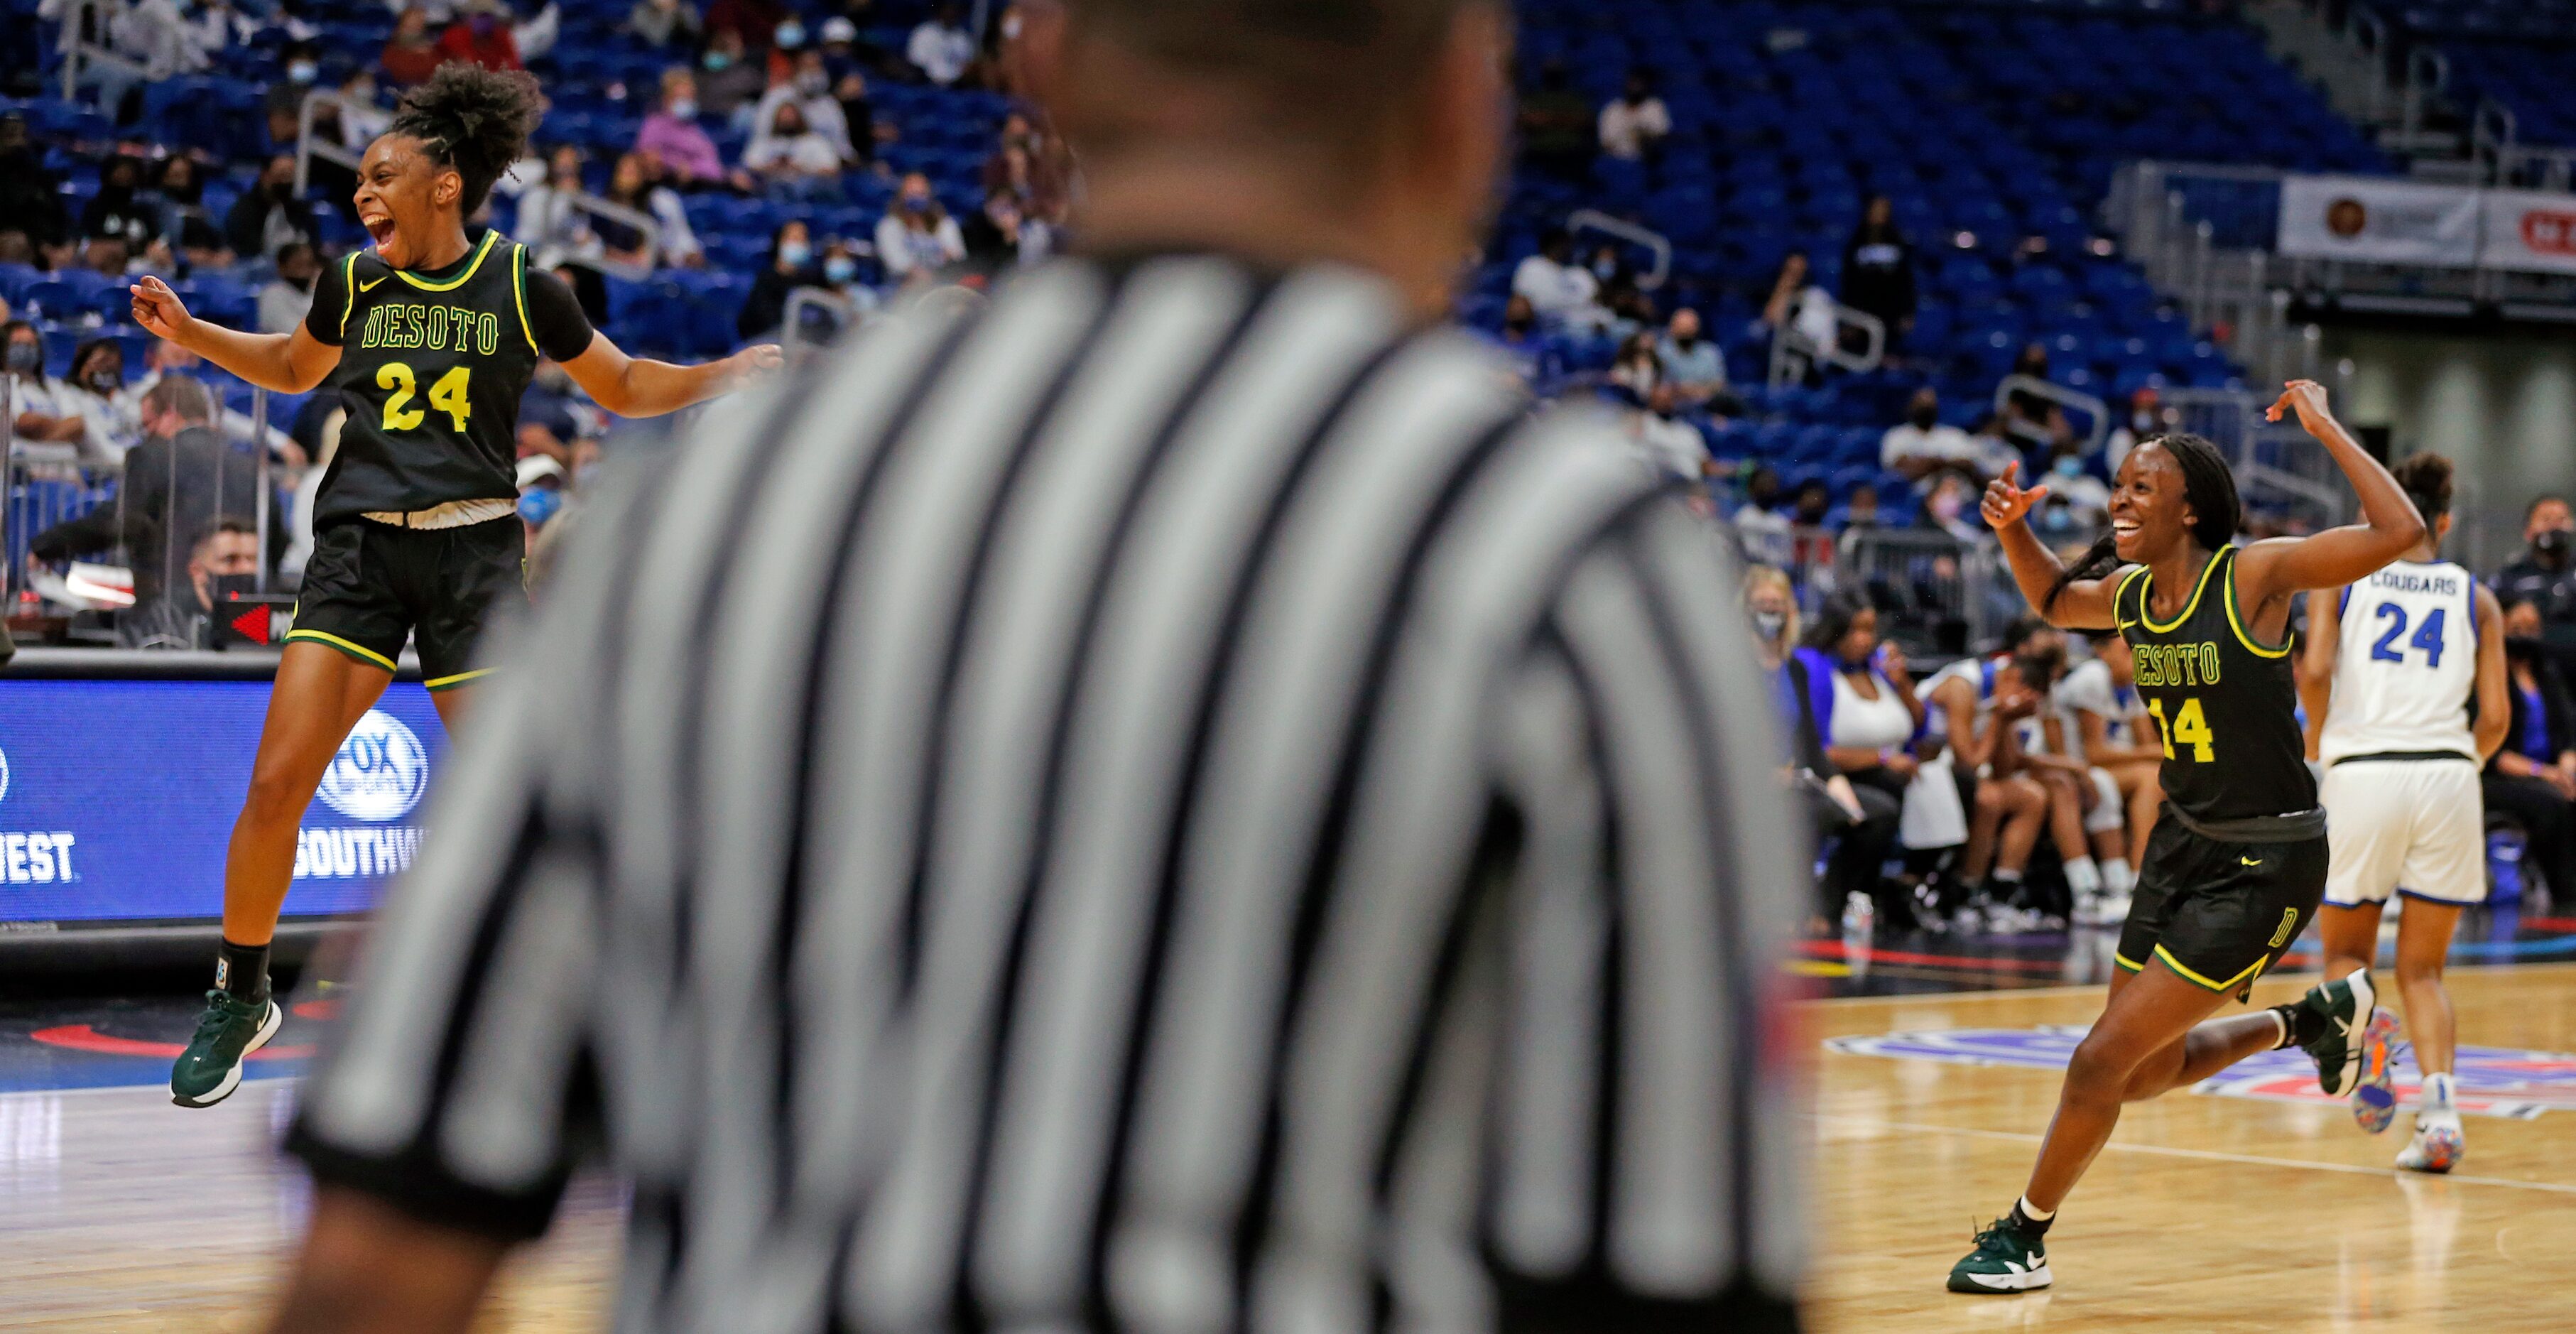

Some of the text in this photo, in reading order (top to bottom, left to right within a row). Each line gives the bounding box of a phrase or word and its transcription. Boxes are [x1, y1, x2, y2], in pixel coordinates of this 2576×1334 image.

[362, 303, 499, 356] DESOTO
[376, 362, 471, 433] 24
[2370, 571, 2457, 596] COUGARS
[2371, 602, 2445, 668] 24
[2148, 697, 2215, 763] 14
[0, 830, 75, 884] EST
